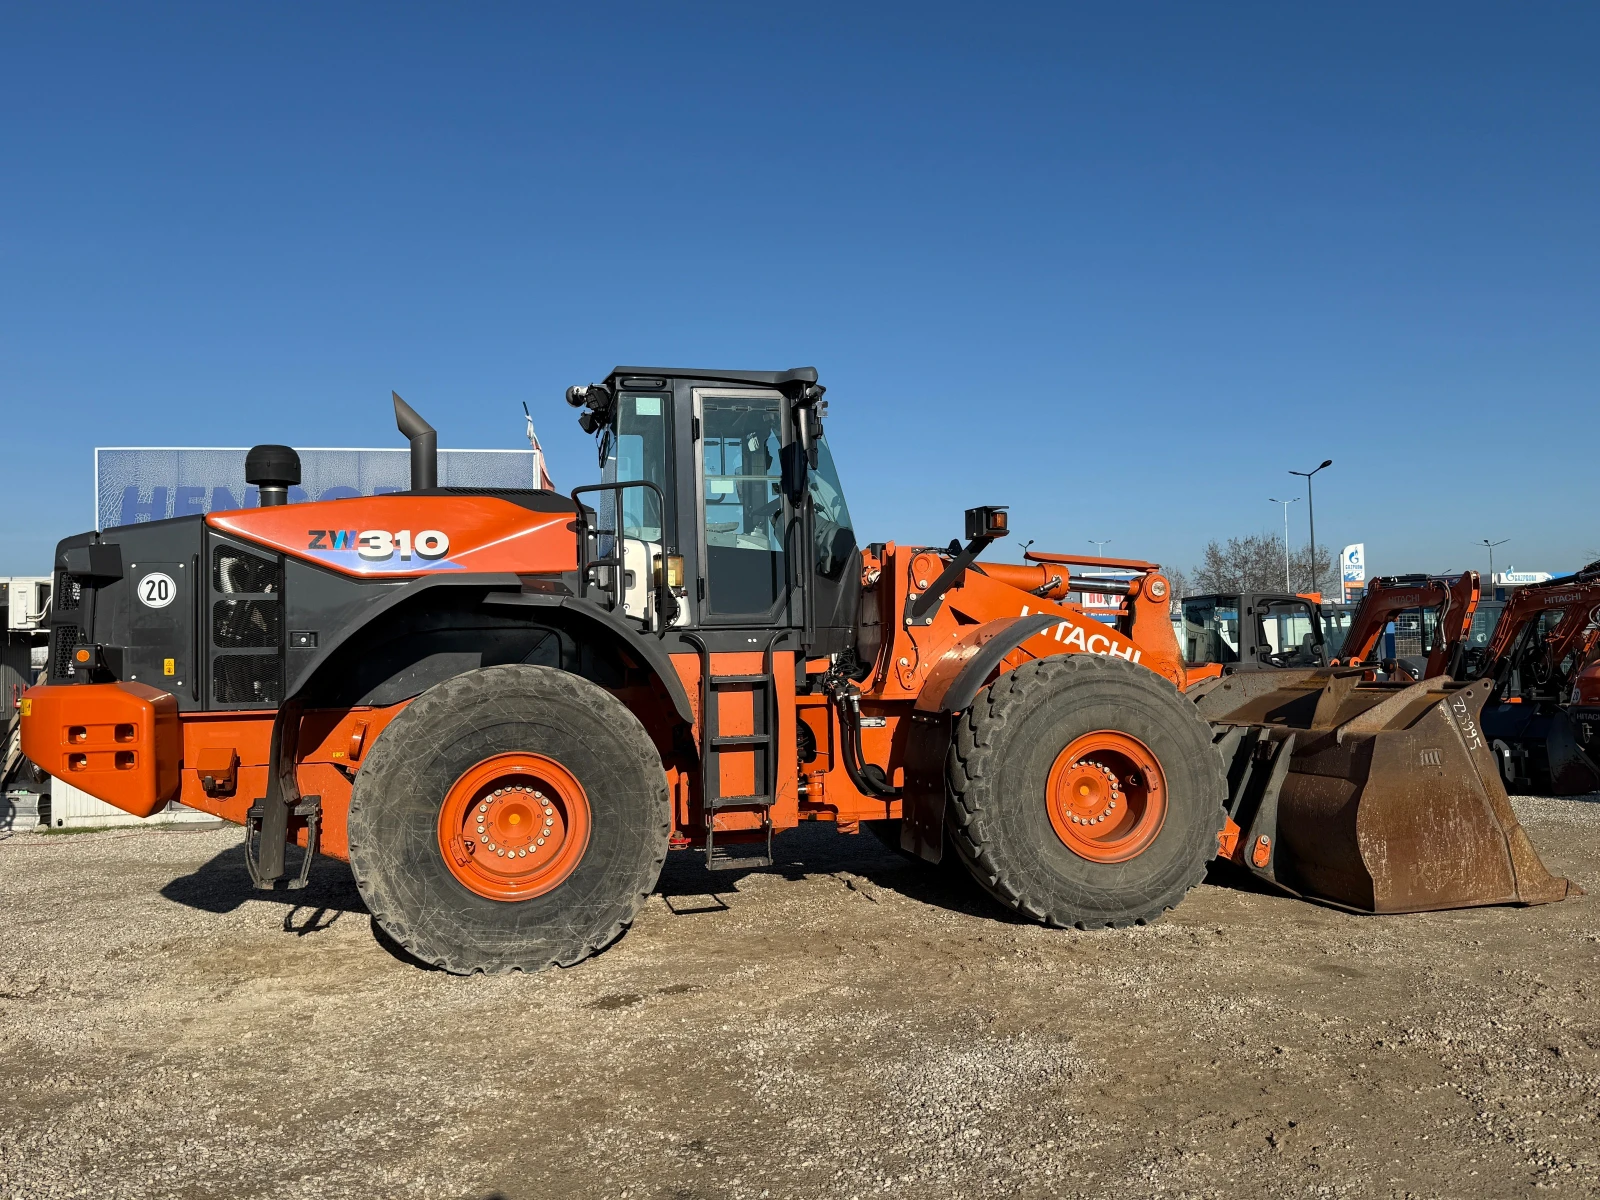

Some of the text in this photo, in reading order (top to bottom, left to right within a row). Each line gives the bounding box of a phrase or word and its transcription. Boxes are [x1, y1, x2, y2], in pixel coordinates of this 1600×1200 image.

[308, 530, 449, 561] ZW310
[145, 579, 169, 602] 20
[1388, 593, 1420, 603] HITACHI
[1544, 592, 1581, 605] HITACHI
[1020, 605, 1142, 664] TACHI
